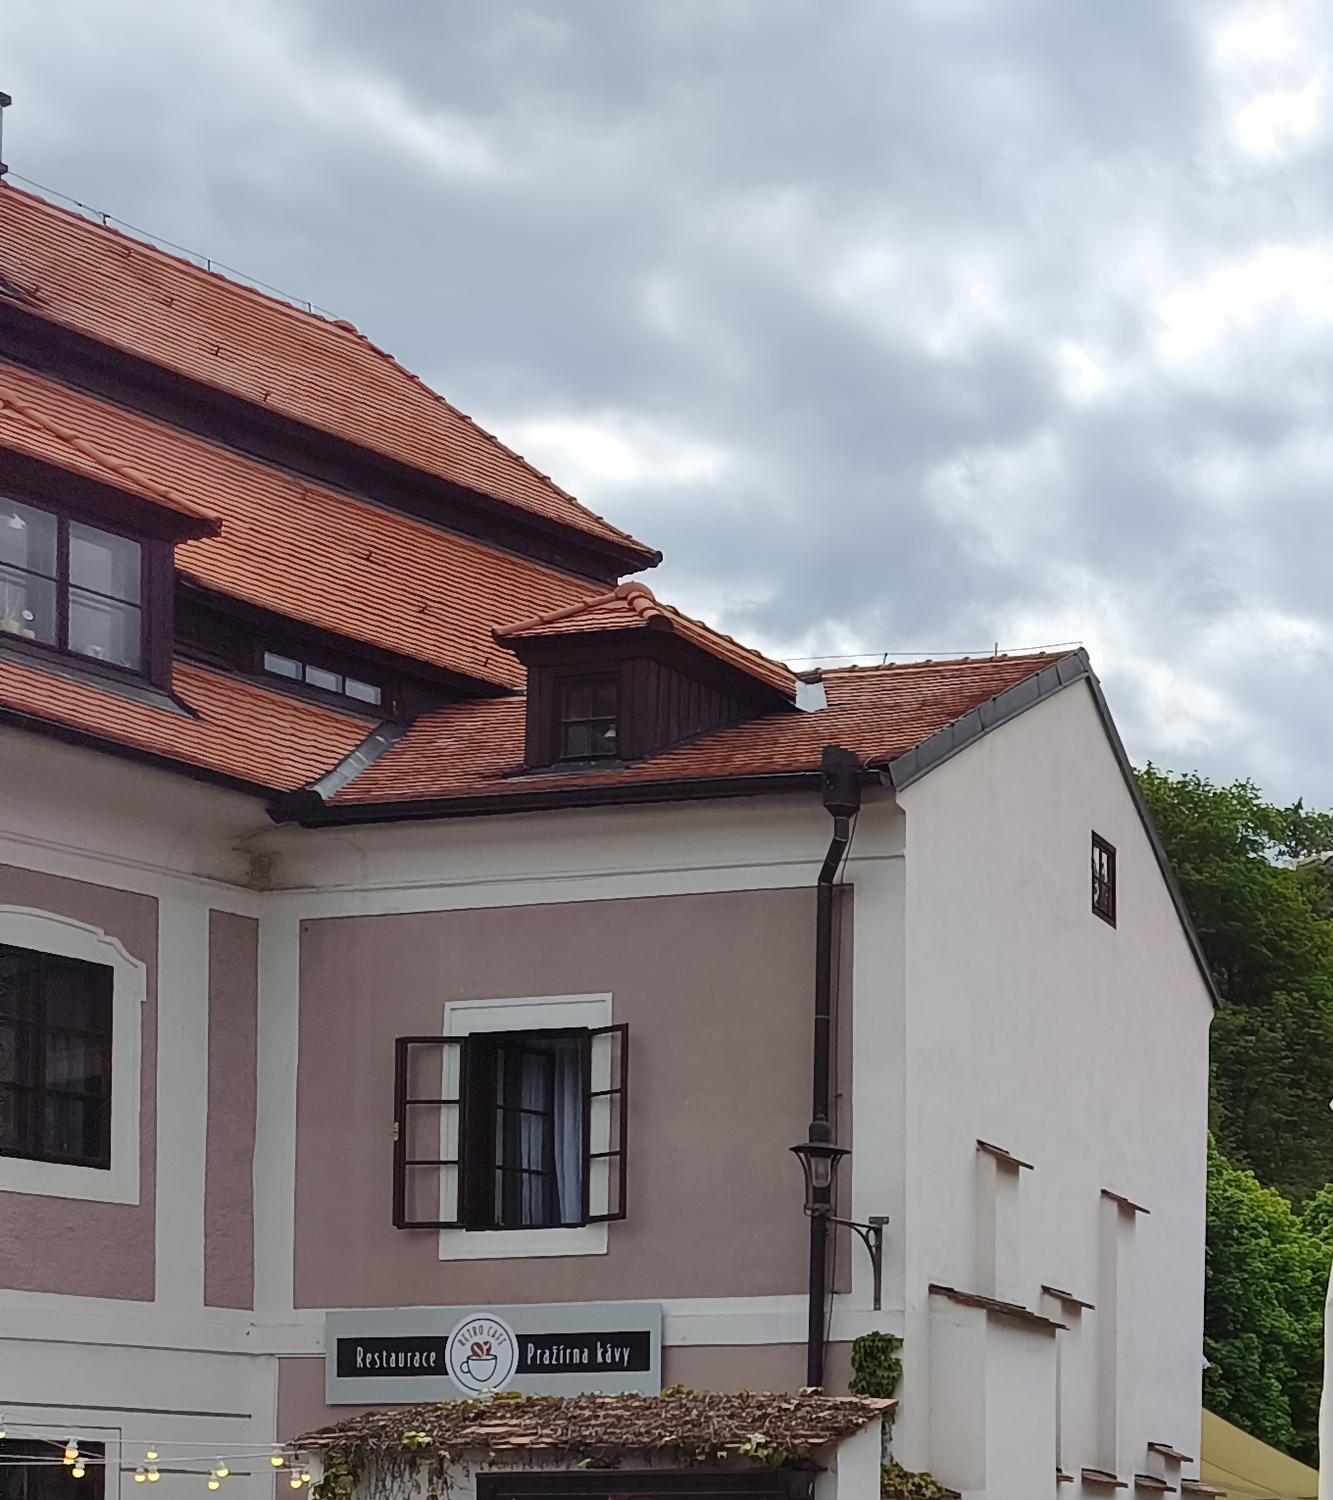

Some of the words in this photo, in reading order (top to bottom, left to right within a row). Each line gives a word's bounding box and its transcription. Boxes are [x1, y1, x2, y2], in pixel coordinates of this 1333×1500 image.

[458, 1325, 484, 1347] RETRO
[356, 1347, 437, 1368] Restaurace
[527, 1343, 588, 1365] Pražírna
[596, 1342, 630, 1367] kávy
